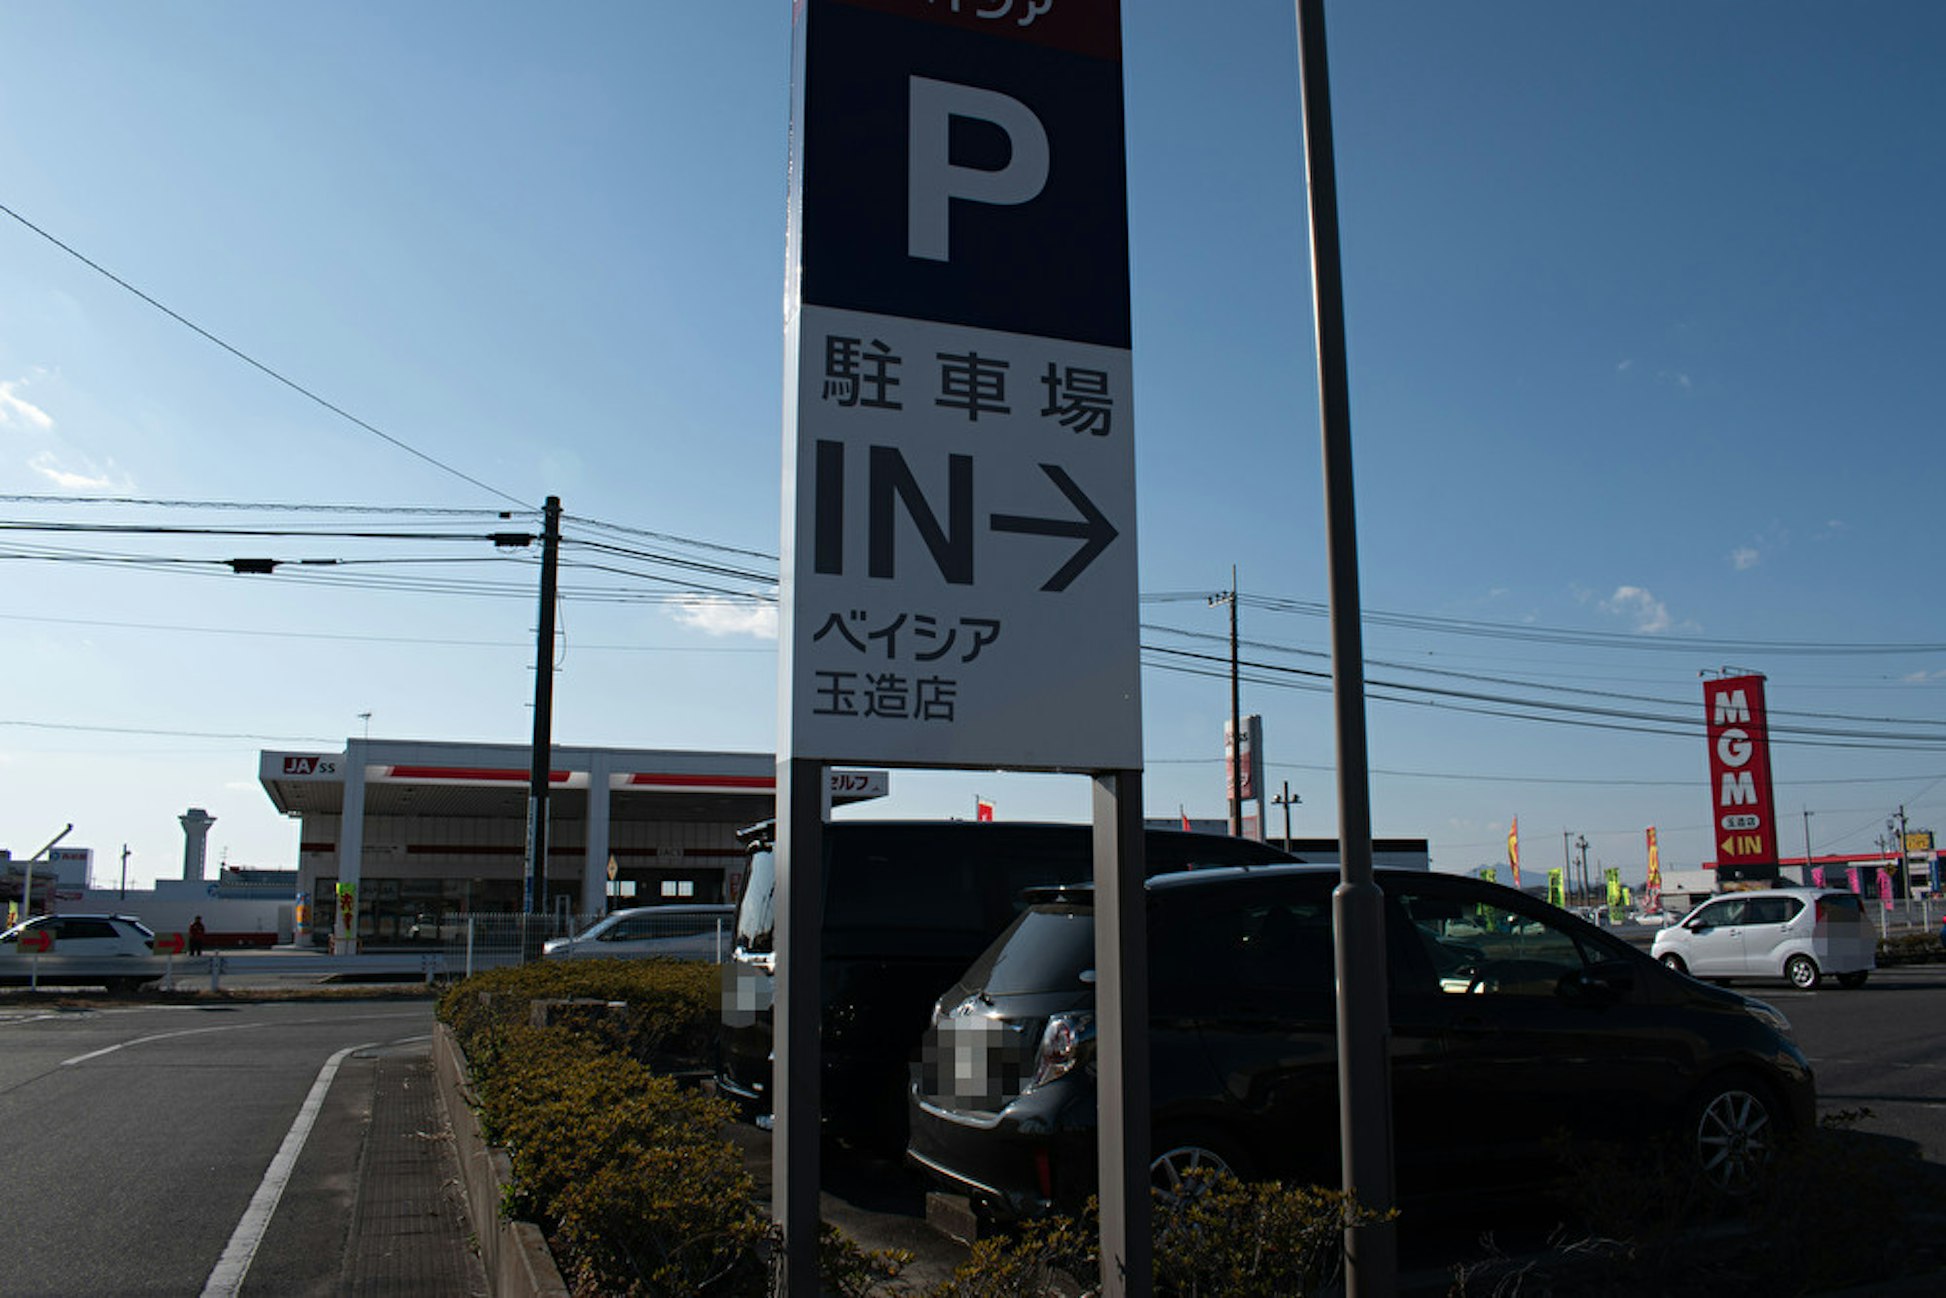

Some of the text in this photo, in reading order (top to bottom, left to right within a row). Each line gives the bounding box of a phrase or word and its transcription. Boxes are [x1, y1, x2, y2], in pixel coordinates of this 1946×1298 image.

[907, 74, 1051, 263] P
[822, 336, 1113, 438] 駐車場
[814, 440, 974, 586] IN
[812, 609, 1001, 664] ベイシア
[812, 670, 957, 723] 玉造店
[285, 759, 310, 773] JA
[1714, 690, 1758, 806] MGM
[1736, 834, 1763, 856] IN
